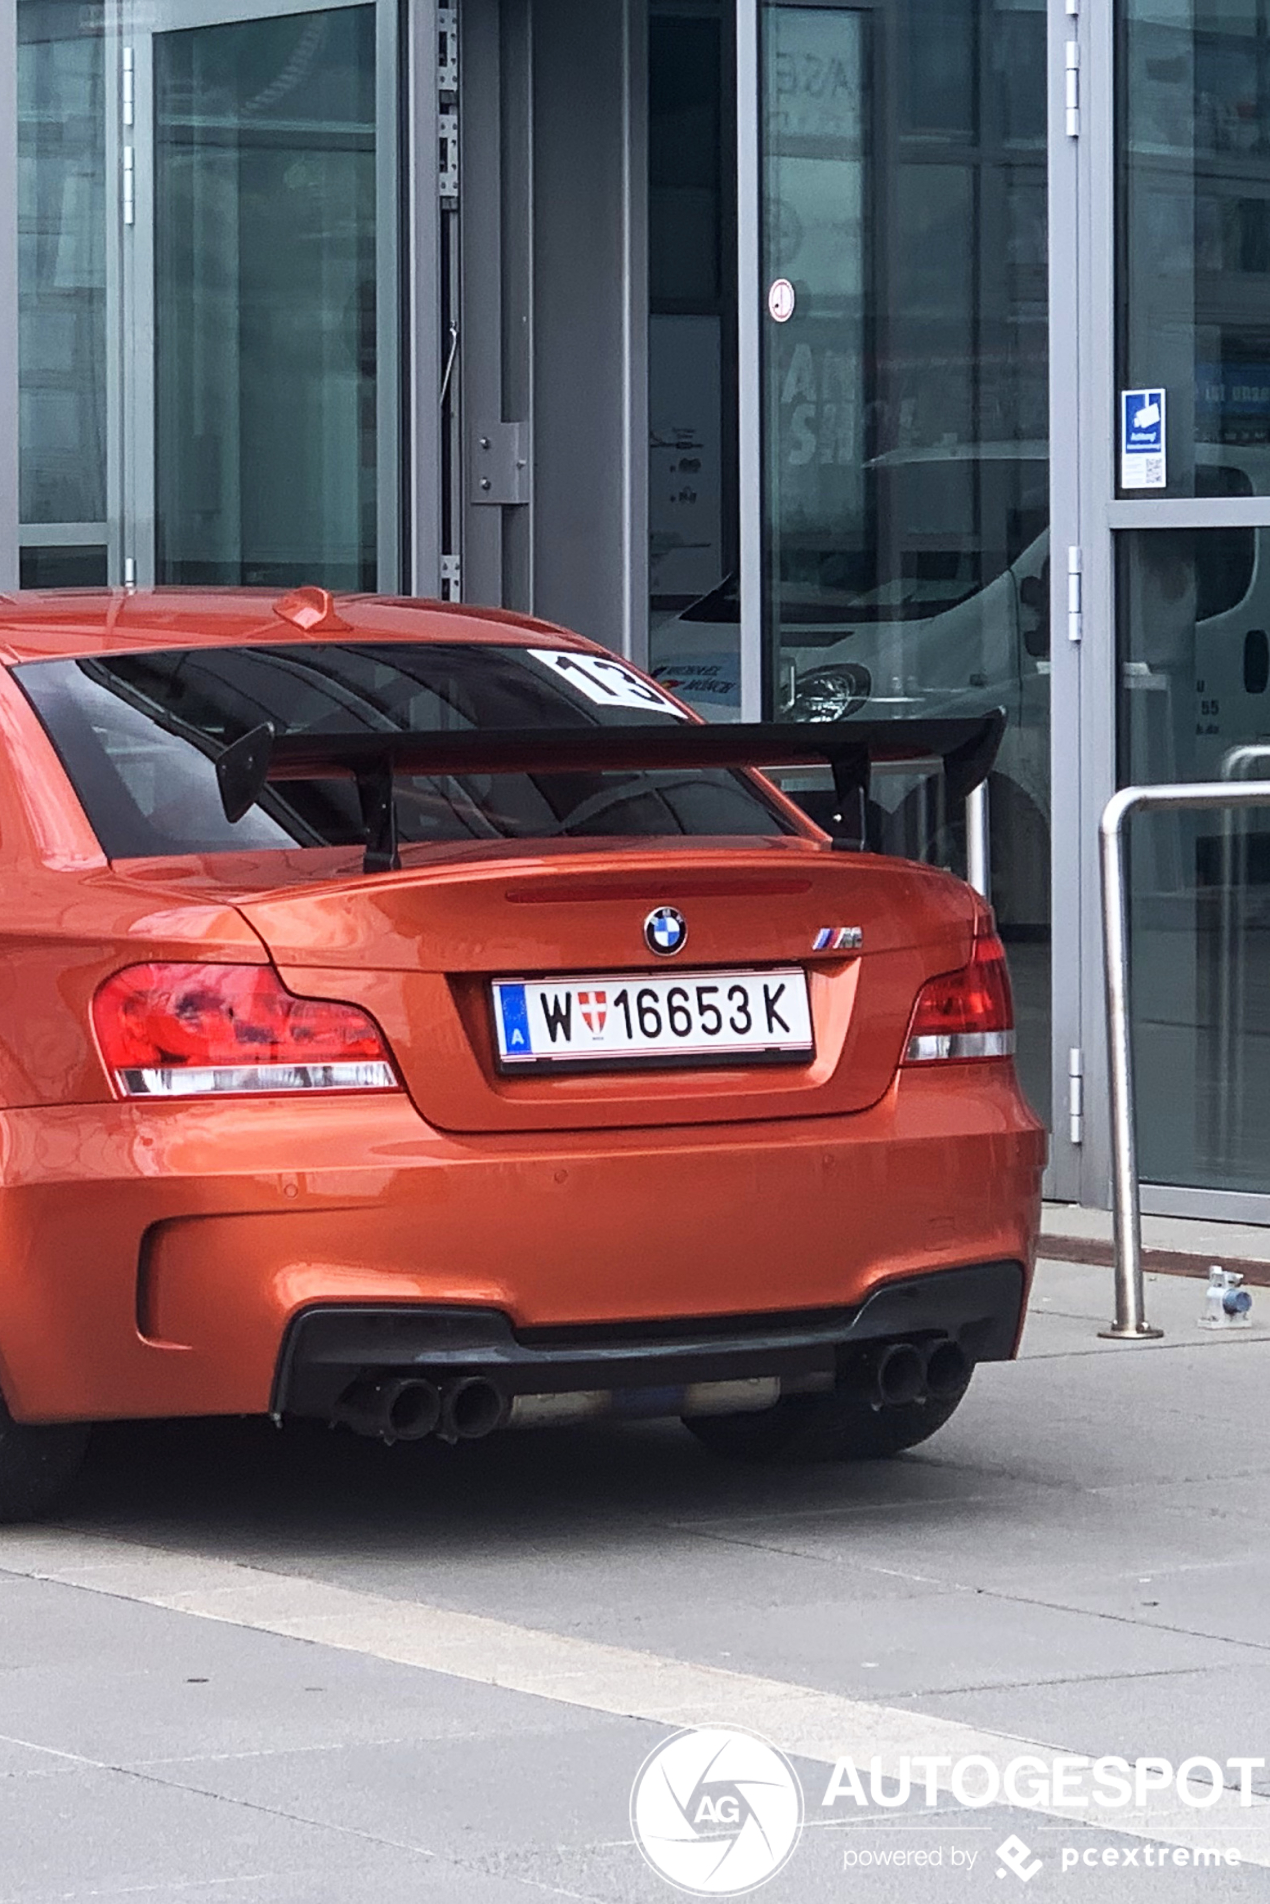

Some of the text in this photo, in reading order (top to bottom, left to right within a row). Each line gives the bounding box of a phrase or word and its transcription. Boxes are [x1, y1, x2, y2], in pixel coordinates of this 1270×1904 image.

[555, 656, 666, 705] 13
[511, 1029, 525, 1046] A
[540, 983, 791, 1043] W 16653 K
